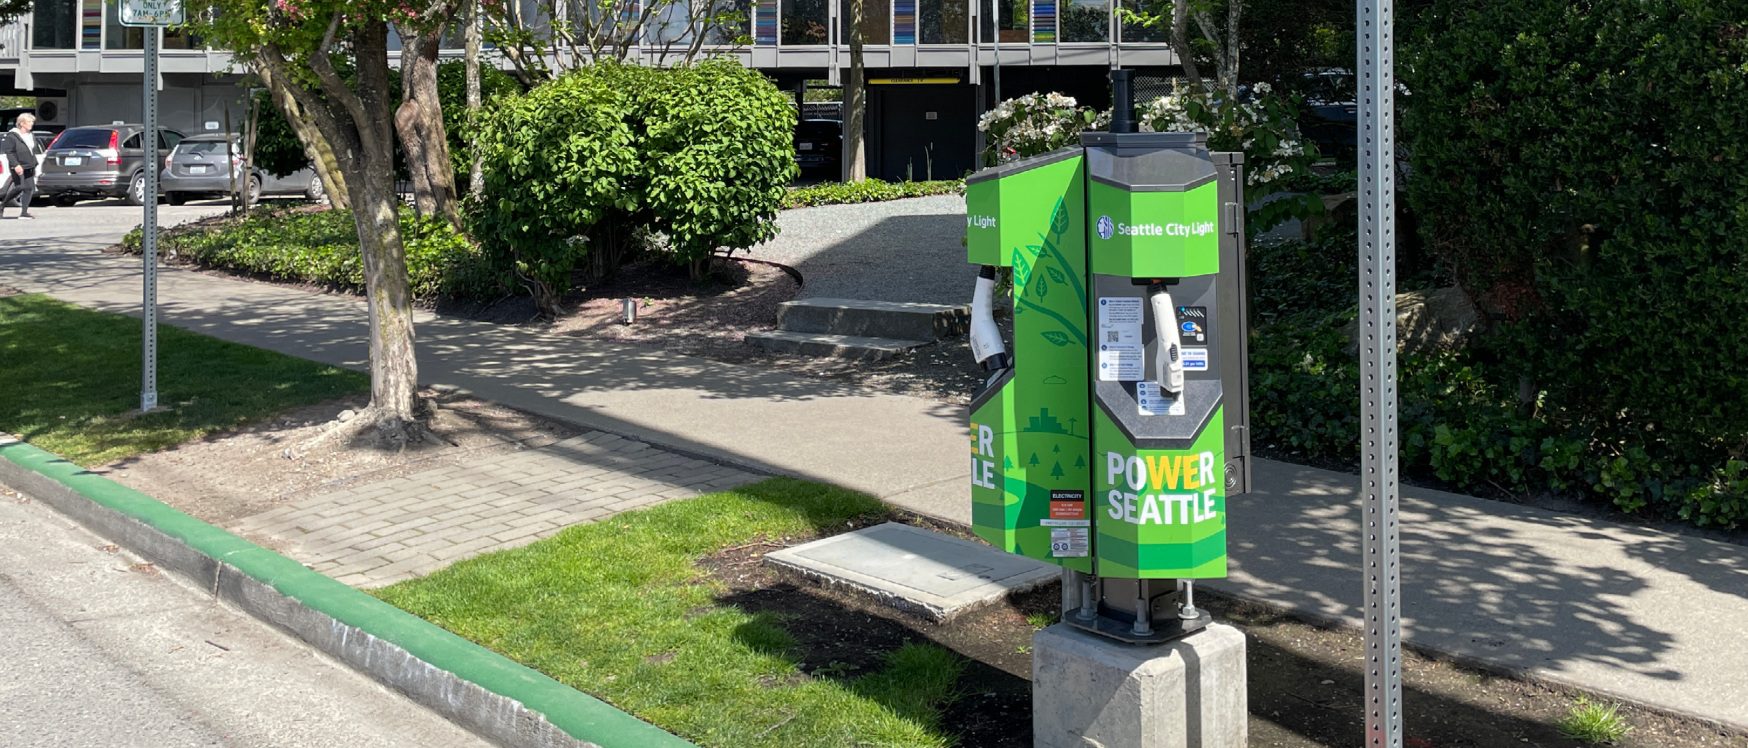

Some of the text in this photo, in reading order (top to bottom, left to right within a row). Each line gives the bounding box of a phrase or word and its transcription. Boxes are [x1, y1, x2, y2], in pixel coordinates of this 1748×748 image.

[143, 1, 161, 9] ONLY
[974, 214, 996, 229] Light
[1118, 222, 1214, 238] Seattle City Light
[972, 457, 995, 490] LE
[1107, 451, 1216, 491] POWER
[1107, 488, 1216, 525] SEATTLE
